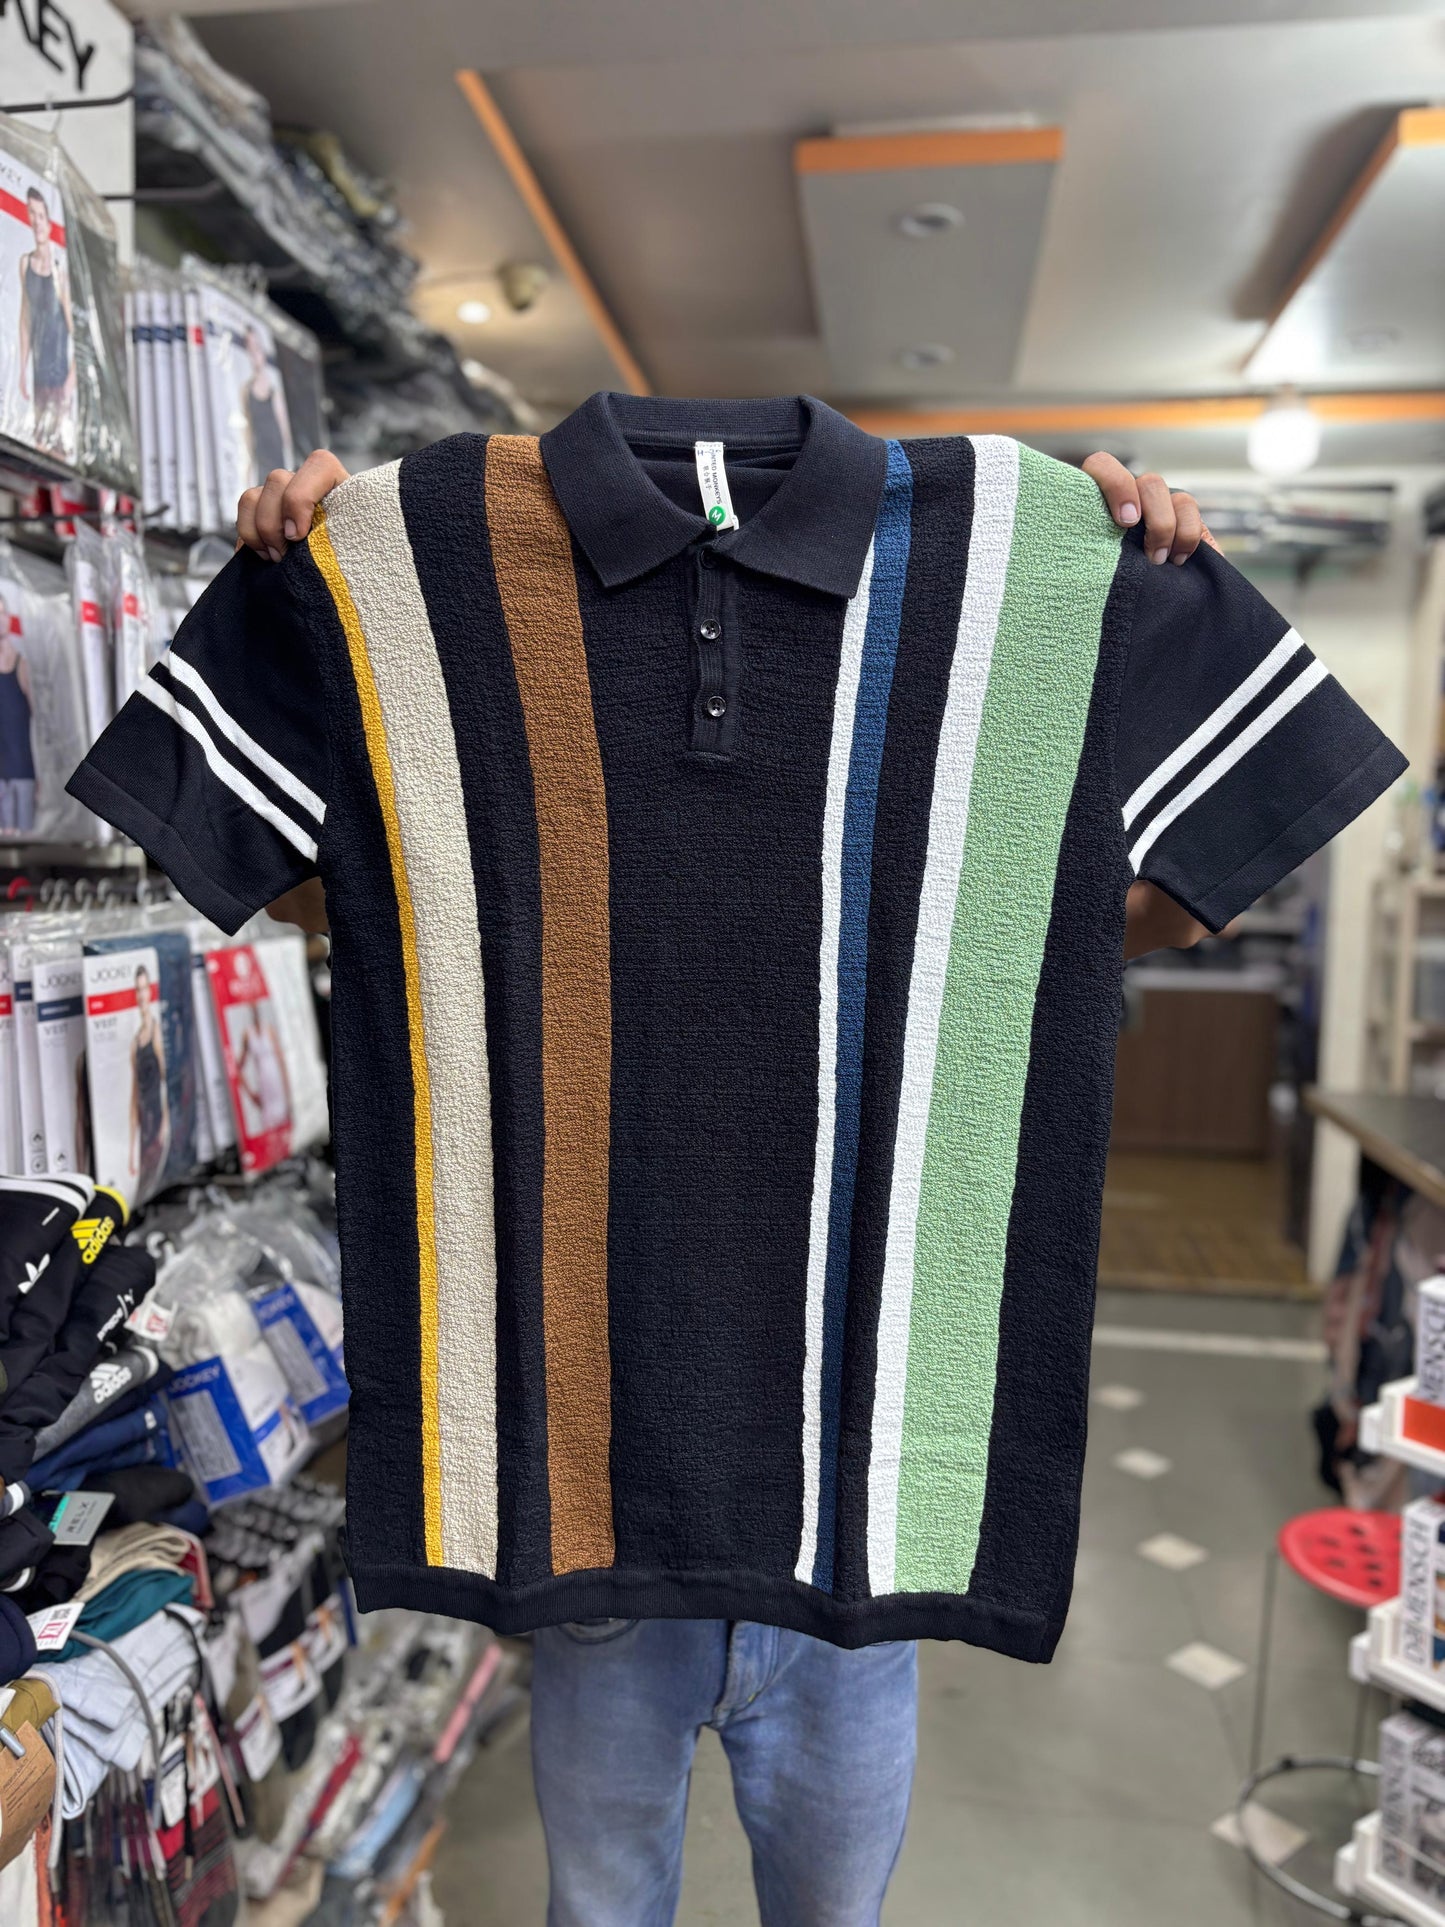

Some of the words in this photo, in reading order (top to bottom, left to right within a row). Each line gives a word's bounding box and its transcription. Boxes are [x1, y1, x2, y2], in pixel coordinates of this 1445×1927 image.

[712, 472, 722, 504] MONKEYS
[82, 1216, 115, 1264] adidas
[94, 1366, 132, 1404] adidas
[168, 1364, 221, 1393] JOCKEY
